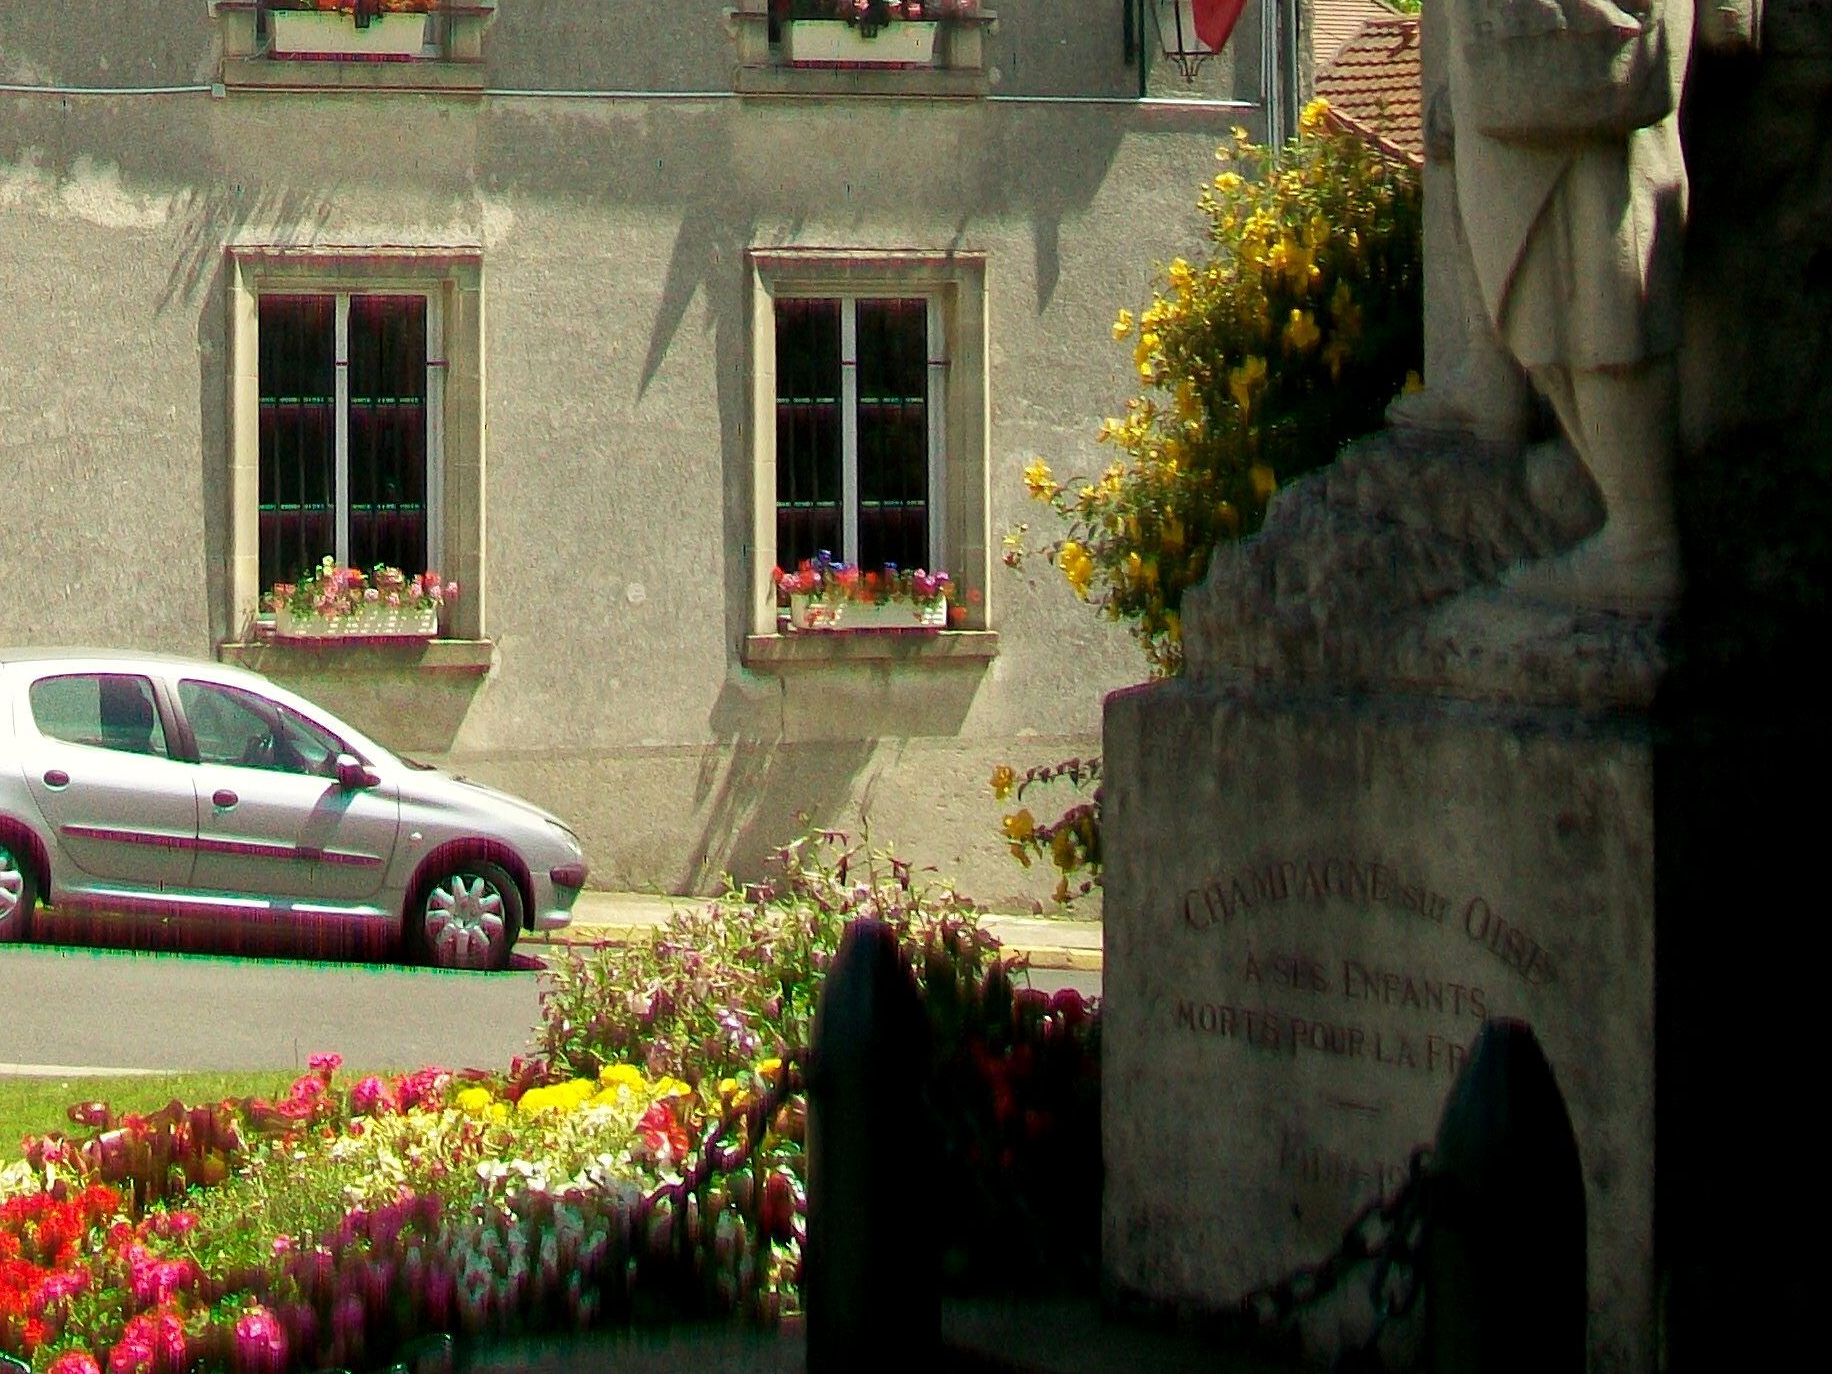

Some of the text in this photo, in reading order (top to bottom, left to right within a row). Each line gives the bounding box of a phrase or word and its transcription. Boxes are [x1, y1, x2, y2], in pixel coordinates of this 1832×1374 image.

[1182, 858, 1391, 932] CHAMPAGNE
[1343, 959, 1489, 1020] ENFANTS
[1175, 997, 1280, 1052] MORTS
[1289, 1017, 1365, 1058] POUR
[1373, 1033, 1417, 1070] LA
